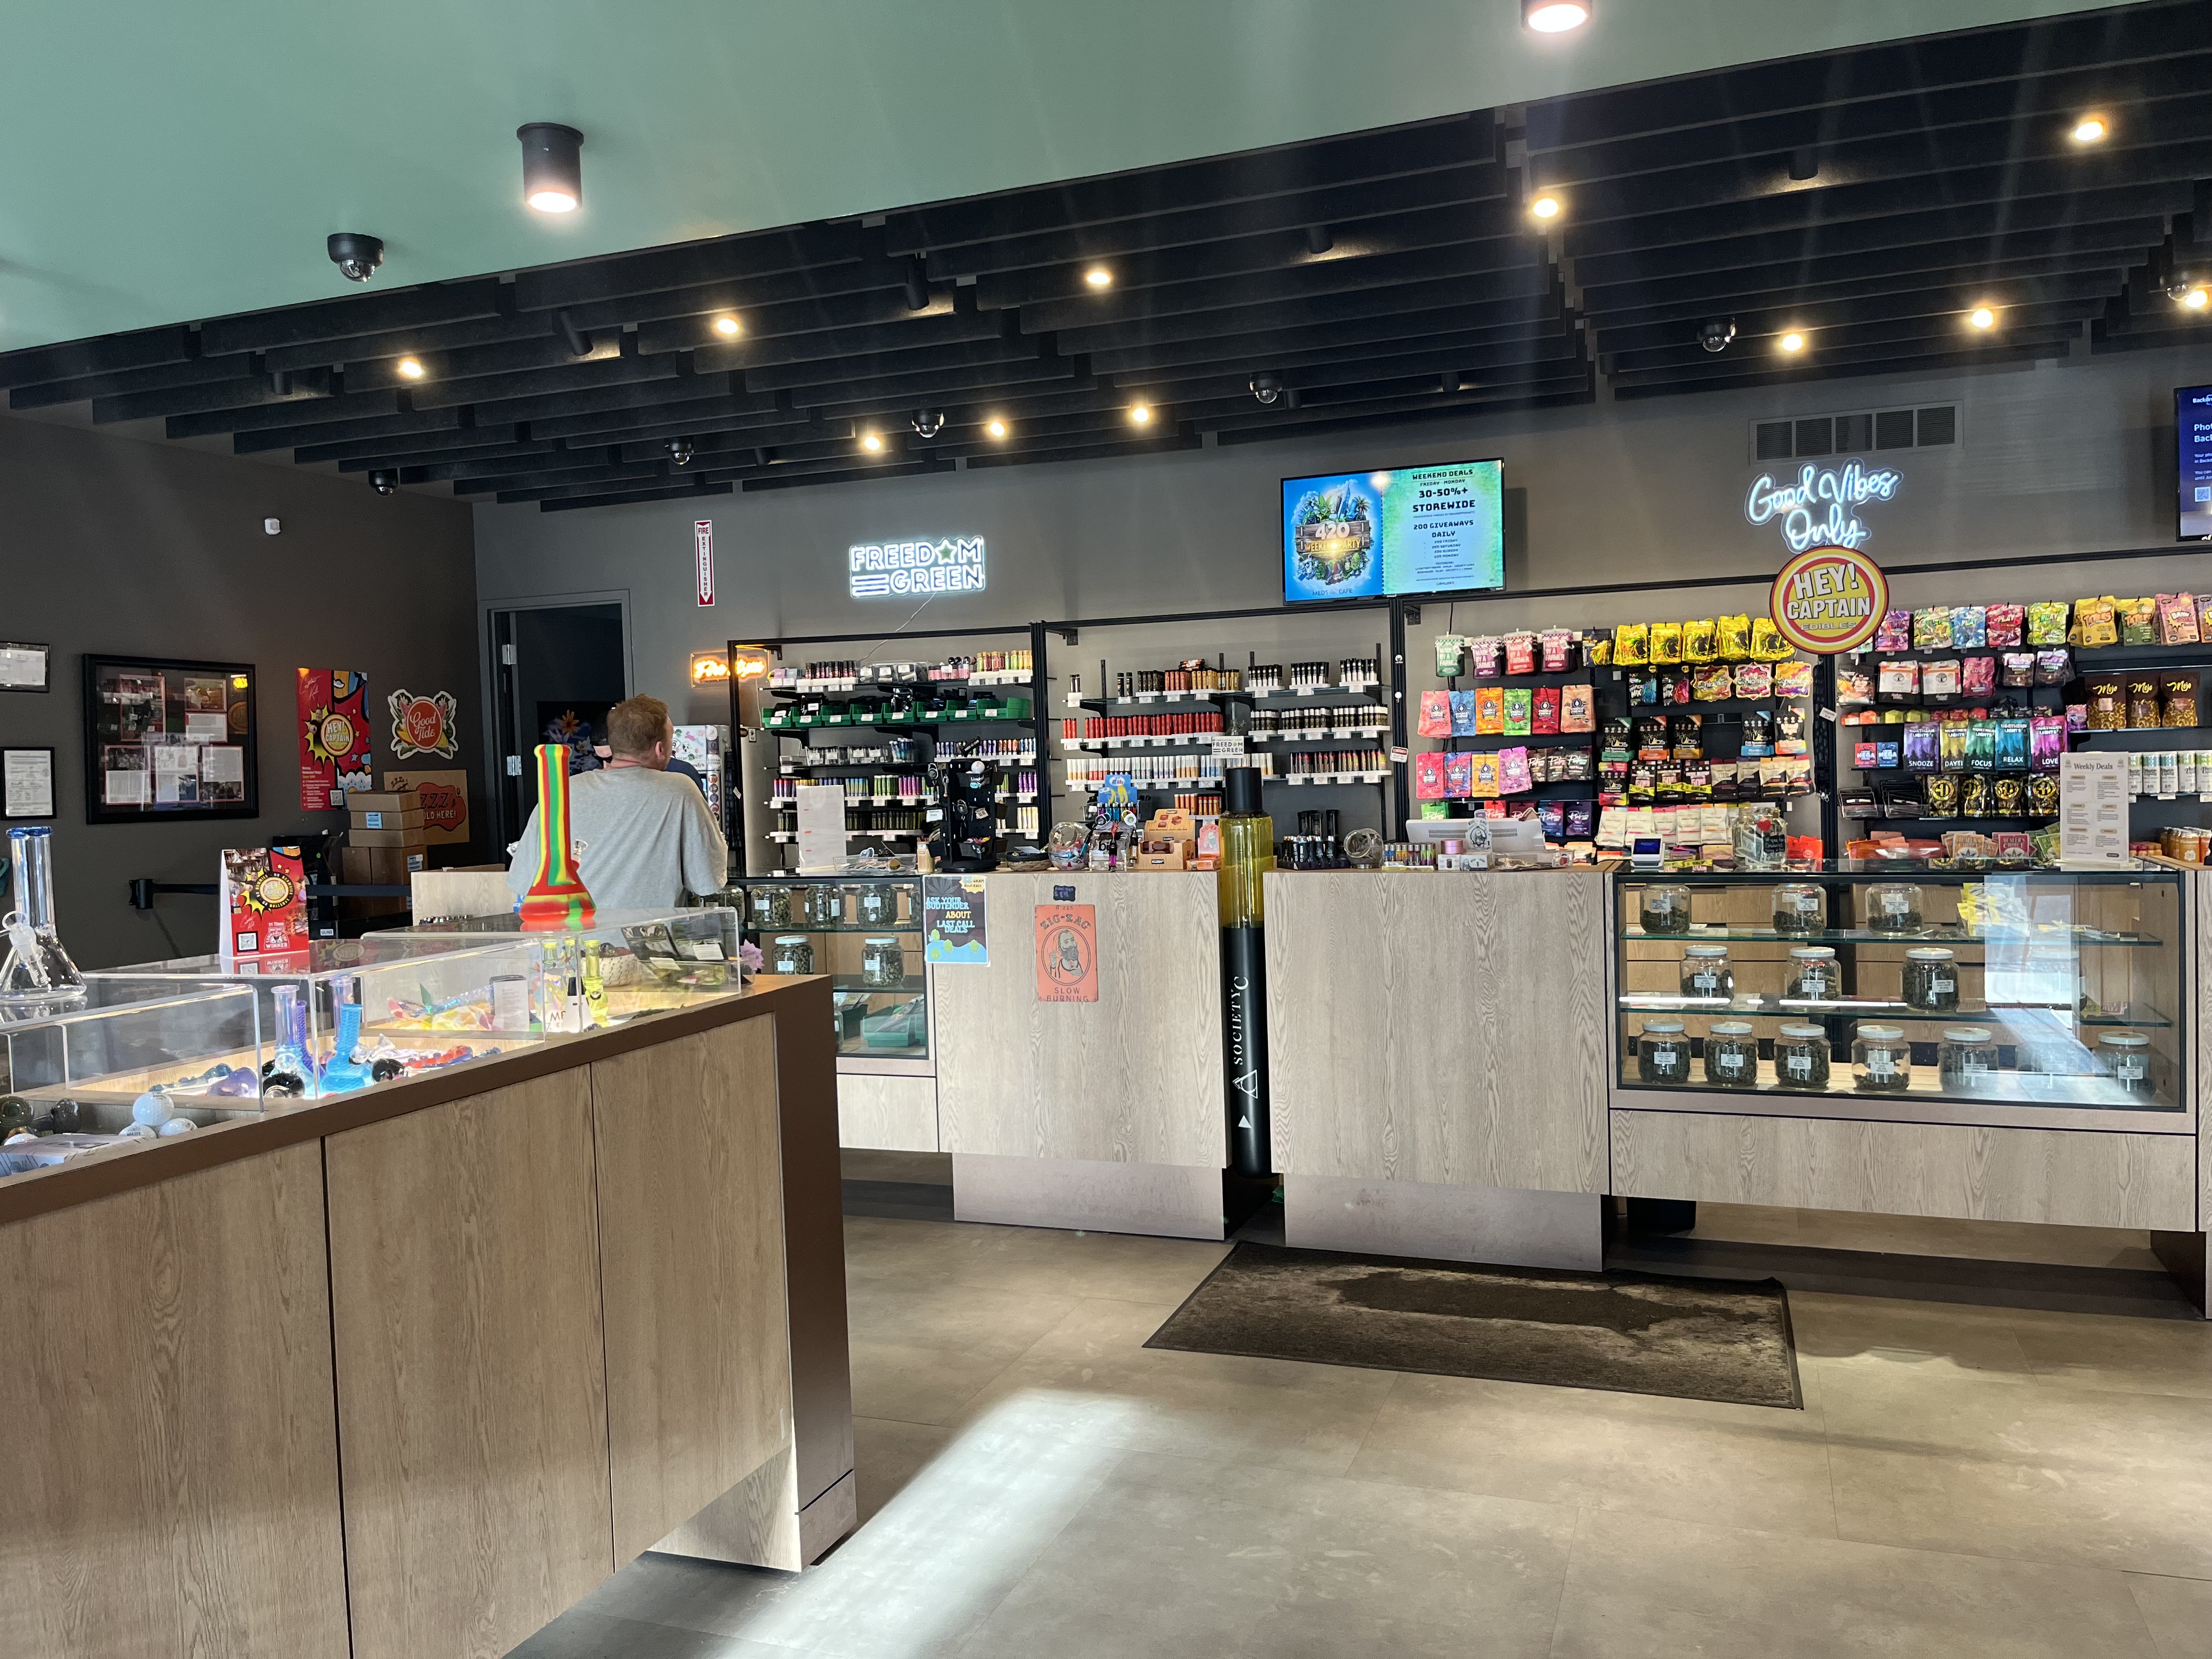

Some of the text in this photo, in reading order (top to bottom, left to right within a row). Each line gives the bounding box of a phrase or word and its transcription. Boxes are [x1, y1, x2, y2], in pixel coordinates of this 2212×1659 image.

[1419, 487, 1468, 498] 30-50%+
[1749, 464, 1898, 522] Good Vibes
[1413, 500, 1475, 512] STOREWIDE
[1430, 520, 1474, 528] GIVEAWAYS
[1786, 503, 1866, 550] Only
[1315, 522, 1350, 540] 420
[1305, 538, 1361, 552] WEEKEN PARTY
[890, 564, 983, 593] GREEN
[1793, 562, 1859, 600] HEY!
[1787, 596, 1871, 619] CAPTAIN
[1801, 622, 1857, 630] EDIBLES
[2093, 684, 2118, 695] Mojo
[2128, 682, 2153, 693] Mojo
[2167, 680, 2192, 692] Mojo
[326, 721, 346, 733] HEY!
[410, 711, 436, 734] Good
[325, 734, 349, 742] CAPTAIN
[418, 725, 436, 741] Tide
[437, 809, 456, 819] HERE!
[1099, 839, 1109, 851] bi
[264, 881, 281, 890] HEY!
[1040, 913, 1092, 930] ZIG-ZAG
[1231, 989, 1243, 1065] SOCIETY
